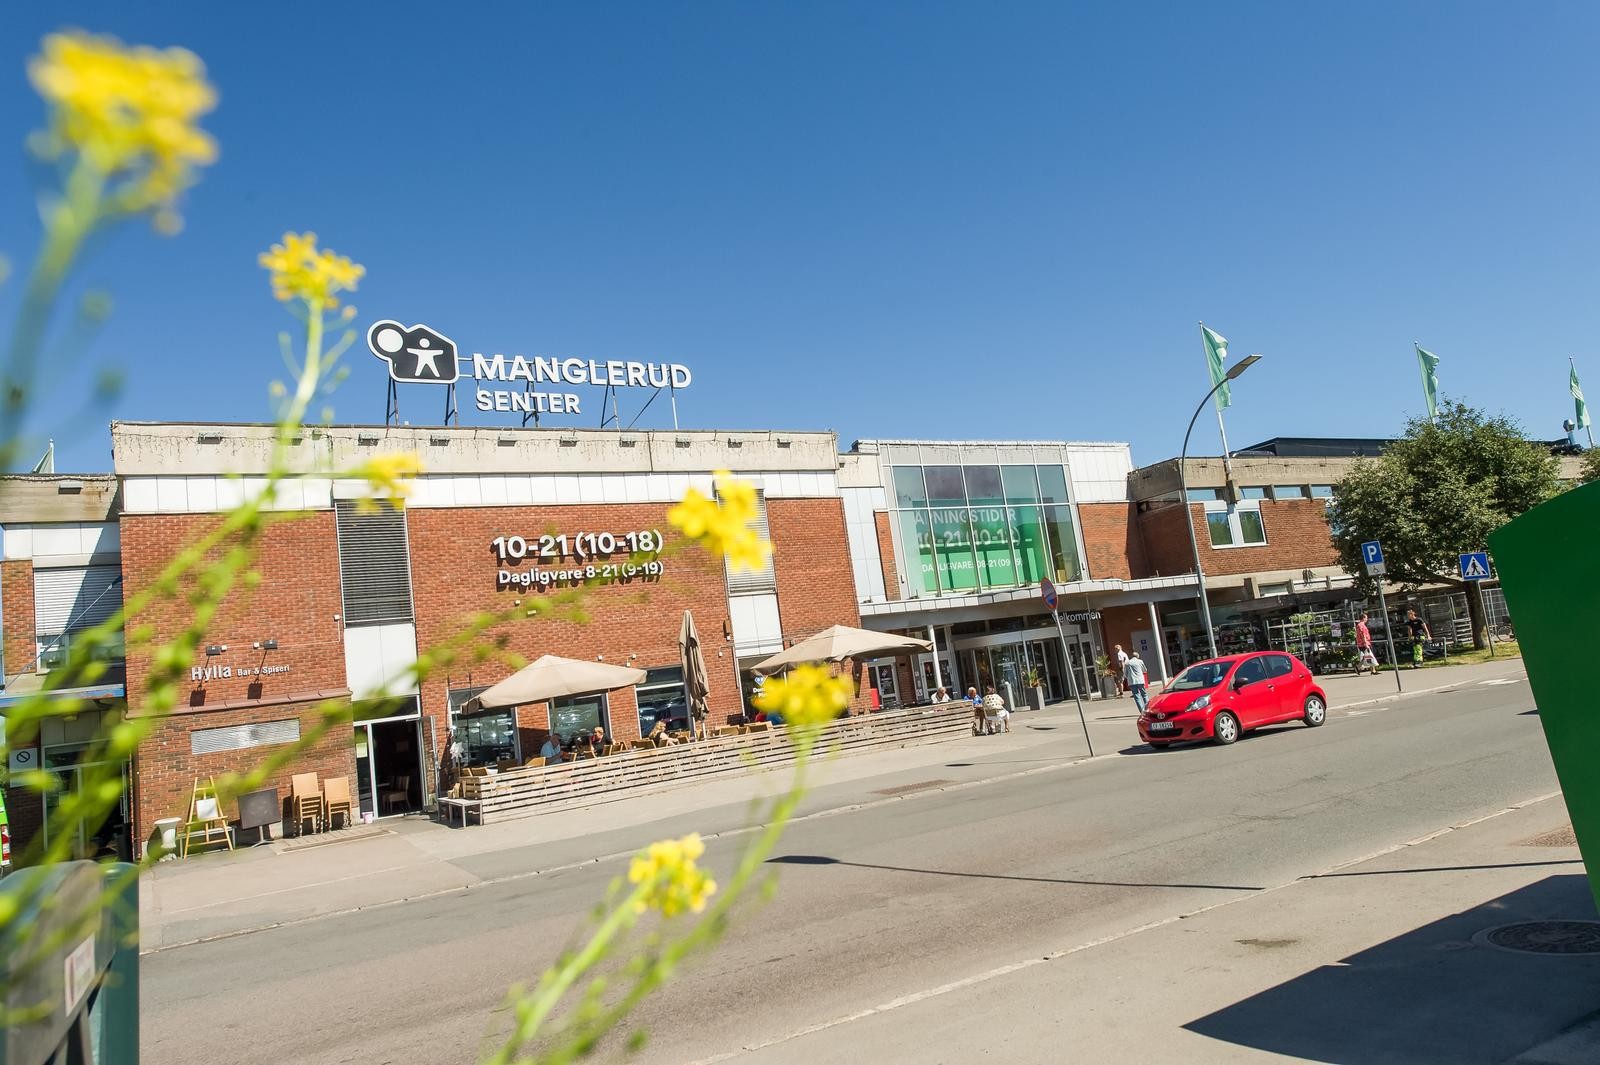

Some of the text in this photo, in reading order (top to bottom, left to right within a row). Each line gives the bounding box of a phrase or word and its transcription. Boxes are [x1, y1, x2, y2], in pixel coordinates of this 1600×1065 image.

[473, 353, 692, 389] MANGLERUD
[476, 389, 581, 414] SENTER
[492, 529, 663, 560] 10-21 (10-18)
[1367, 545, 1377, 562] P
[585, 564, 618, 579] 8-21
[622, 560, 664, 578] (9-19)
[191, 665, 232, 682] Hylla
[237, 668, 251, 677] Bar
[253, 667, 260, 675] &
